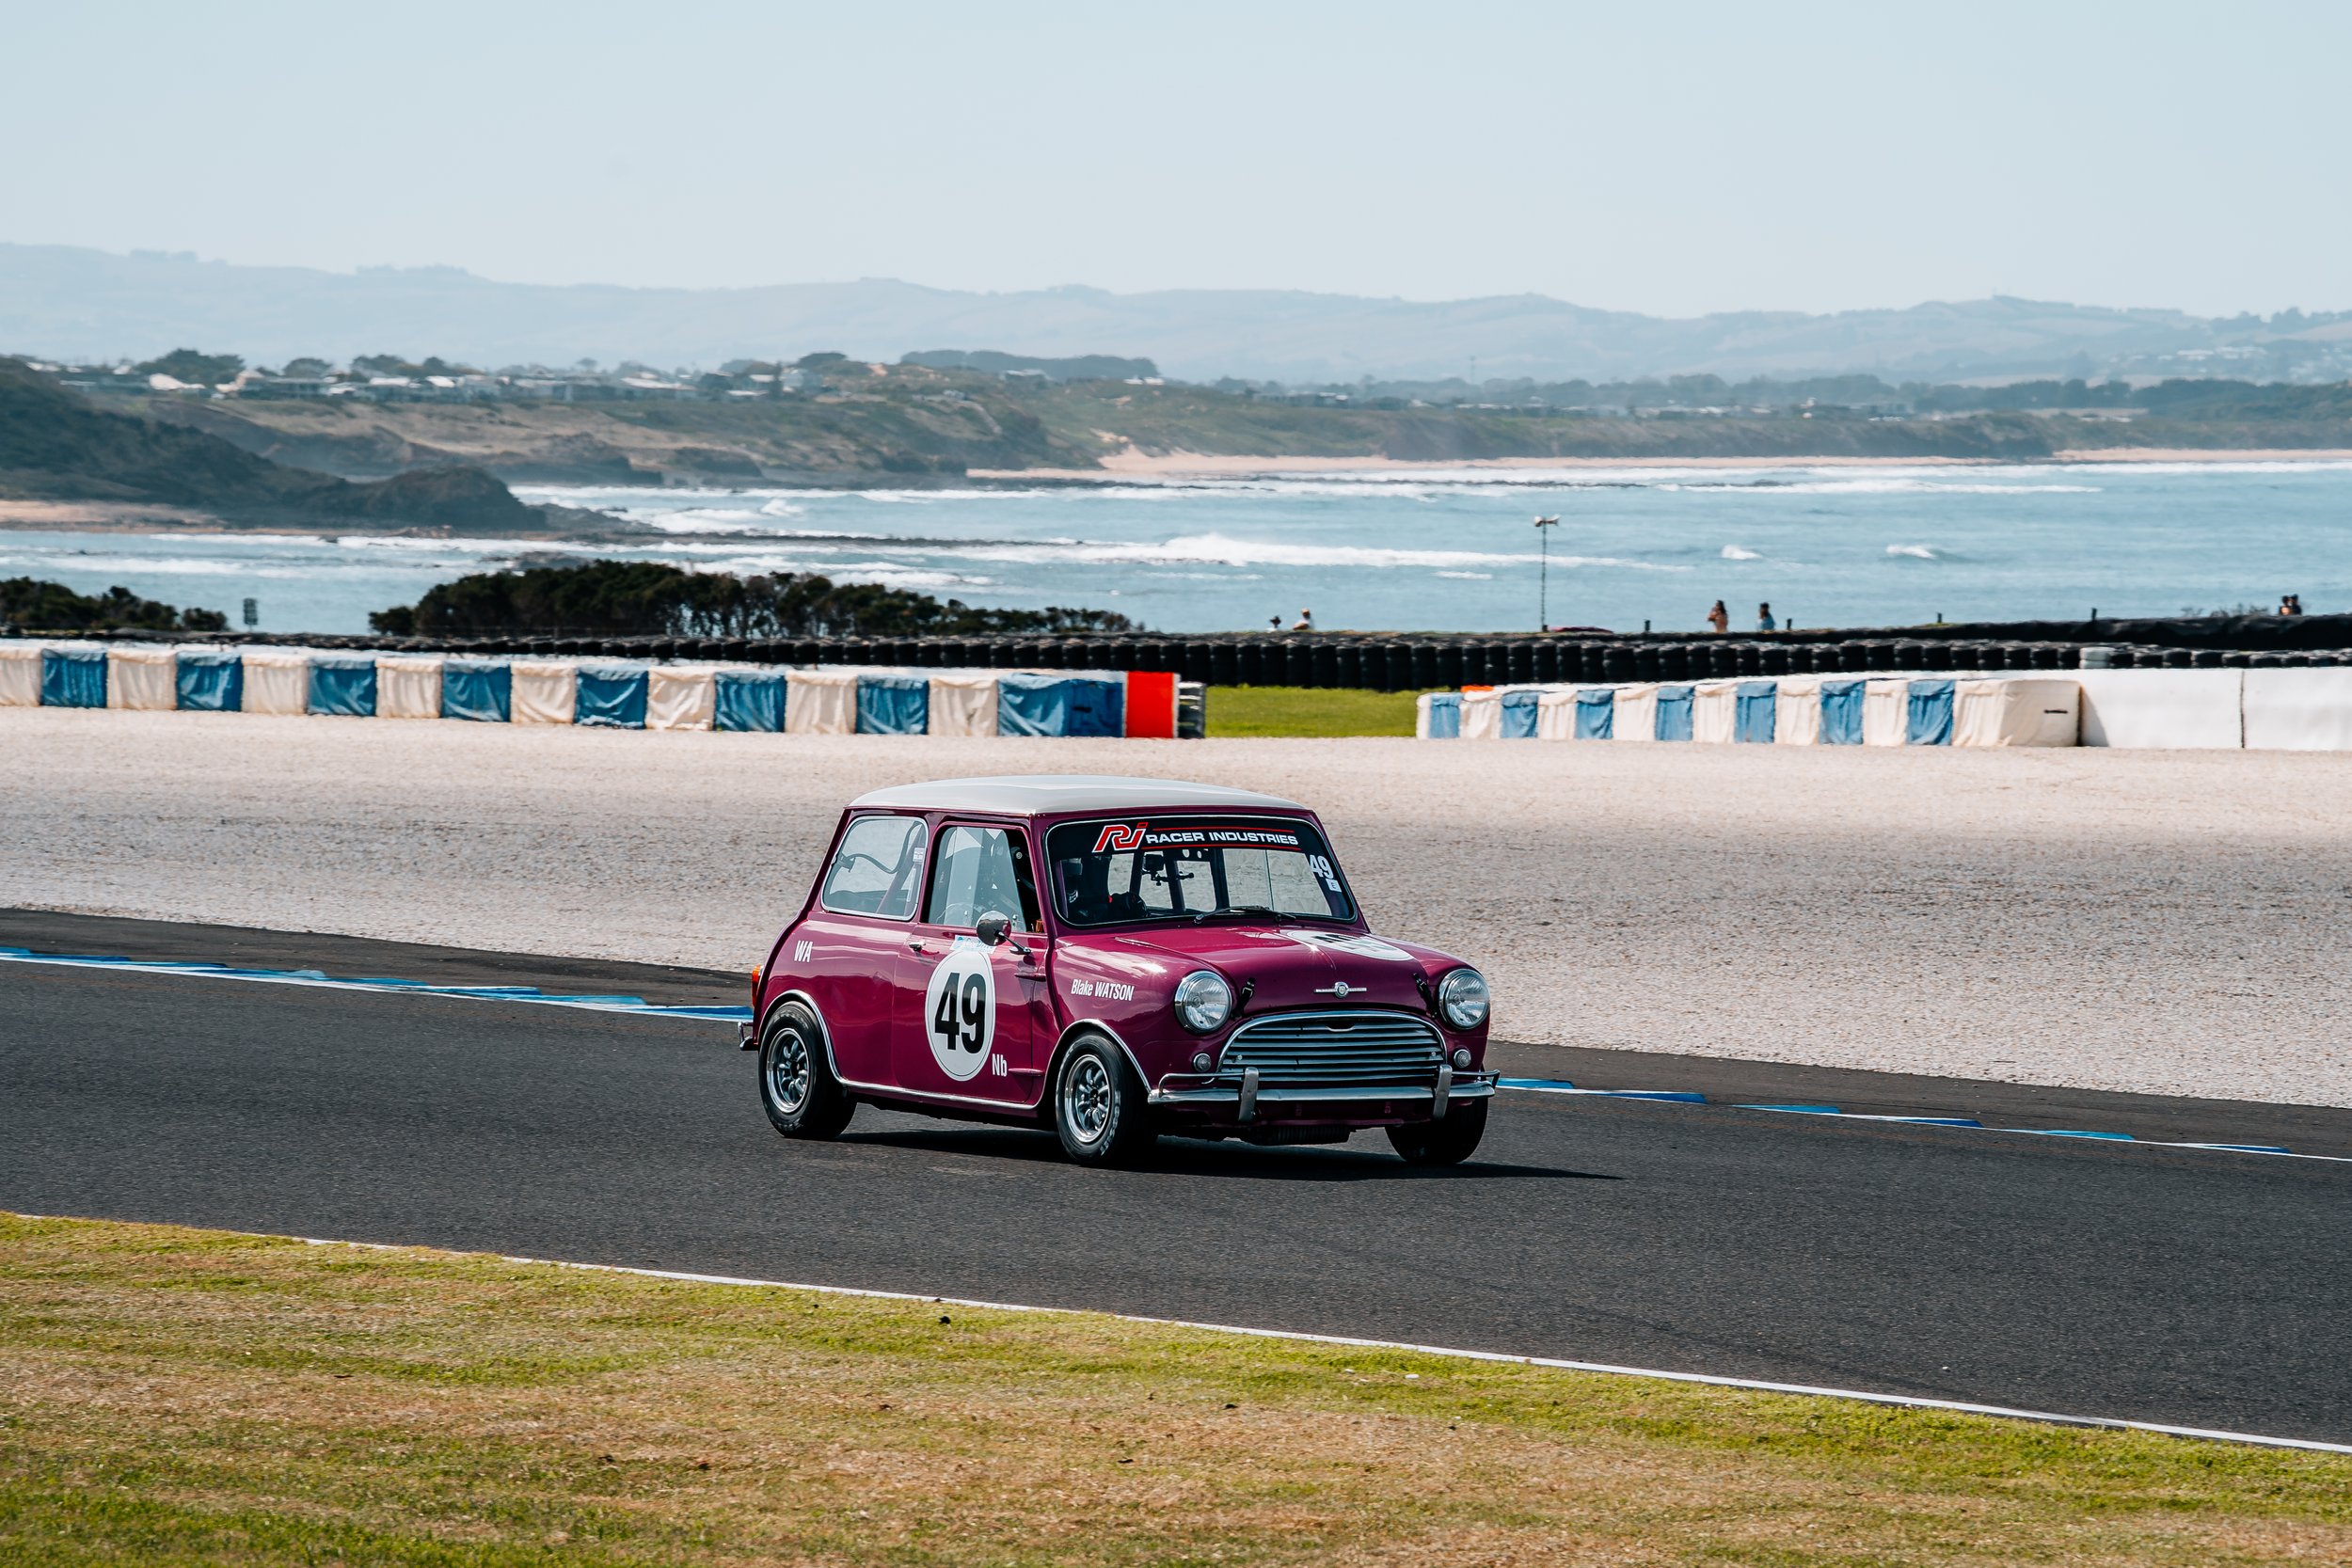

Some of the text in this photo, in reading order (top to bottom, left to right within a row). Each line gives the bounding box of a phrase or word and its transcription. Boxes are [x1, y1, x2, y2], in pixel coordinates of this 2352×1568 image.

[1145, 832, 1299, 846] RACER INDUSTRIES
[1309, 854, 1334, 879] 49
[794, 940, 814, 963] WA
[1071, 978, 1135, 1002] Blake WATSON
[934, 972, 987, 1054] 49
[992, 1053, 1008, 1077] Nb
